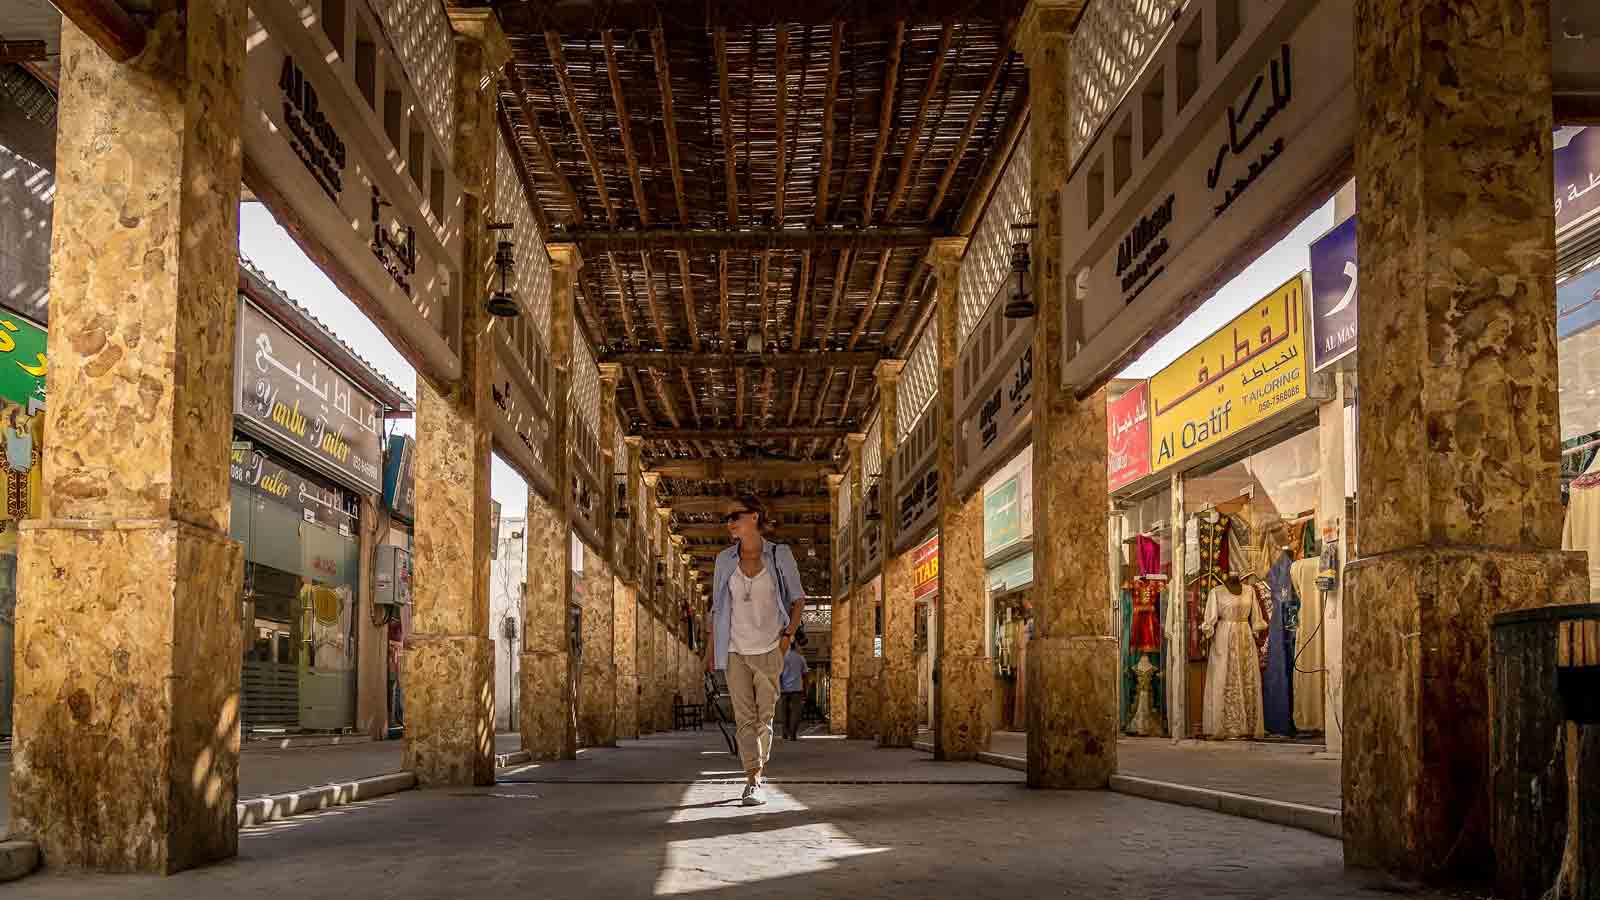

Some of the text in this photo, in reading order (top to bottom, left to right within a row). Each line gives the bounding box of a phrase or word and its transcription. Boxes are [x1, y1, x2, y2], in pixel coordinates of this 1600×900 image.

[1240, 367, 1301, 405] TAILORING
[1242, 344, 1299, 385] للخياطة
[255, 380, 351, 464] Yanbu Tailor
[1157, 432, 1176, 465] Al
[1181, 400, 1233, 450] Qatif
[245, 449, 290, 497] Tailor
